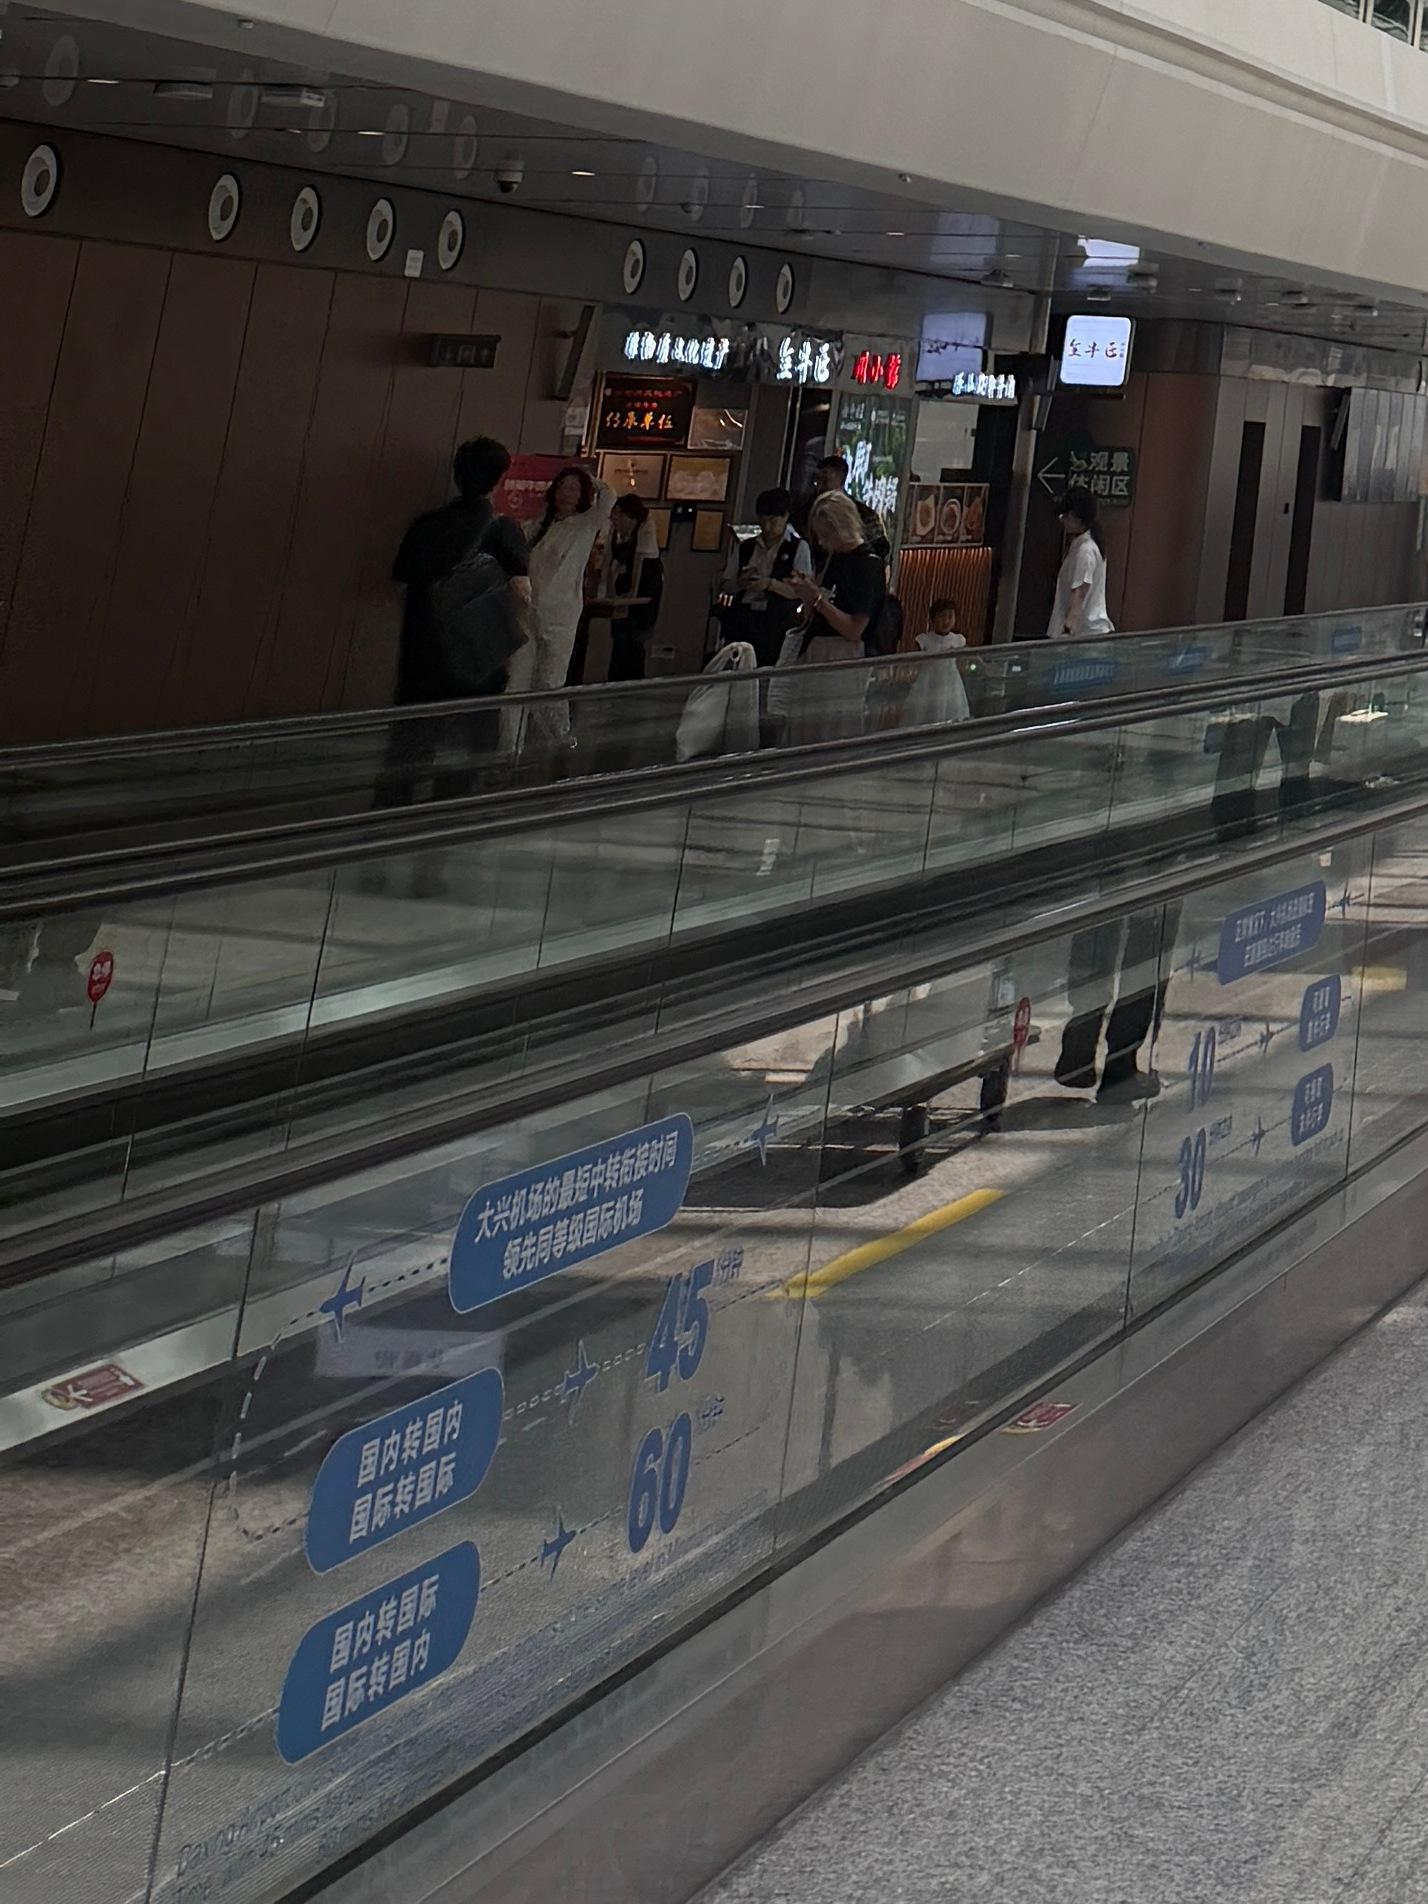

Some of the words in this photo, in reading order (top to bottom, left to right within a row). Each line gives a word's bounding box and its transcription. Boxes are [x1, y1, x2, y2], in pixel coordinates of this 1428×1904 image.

[474, 1129, 680, 1245] 大兴机场的最短中转衔接时间
[1173, 1126, 1207, 1219] 30
[502, 1188, 645, 1282] 领先同等级国际机场
[645, 1258, 715, 1393] 45
[356, 1400, 463, 1490] 国内转国内
[628, 1410, 693, 1553] 60
[347, 1455, 459, 1547] 国际转国际
[331, 1571, 440, 1675] 国内转国际
[320, 1630, 431, 1733] 国际转国内
